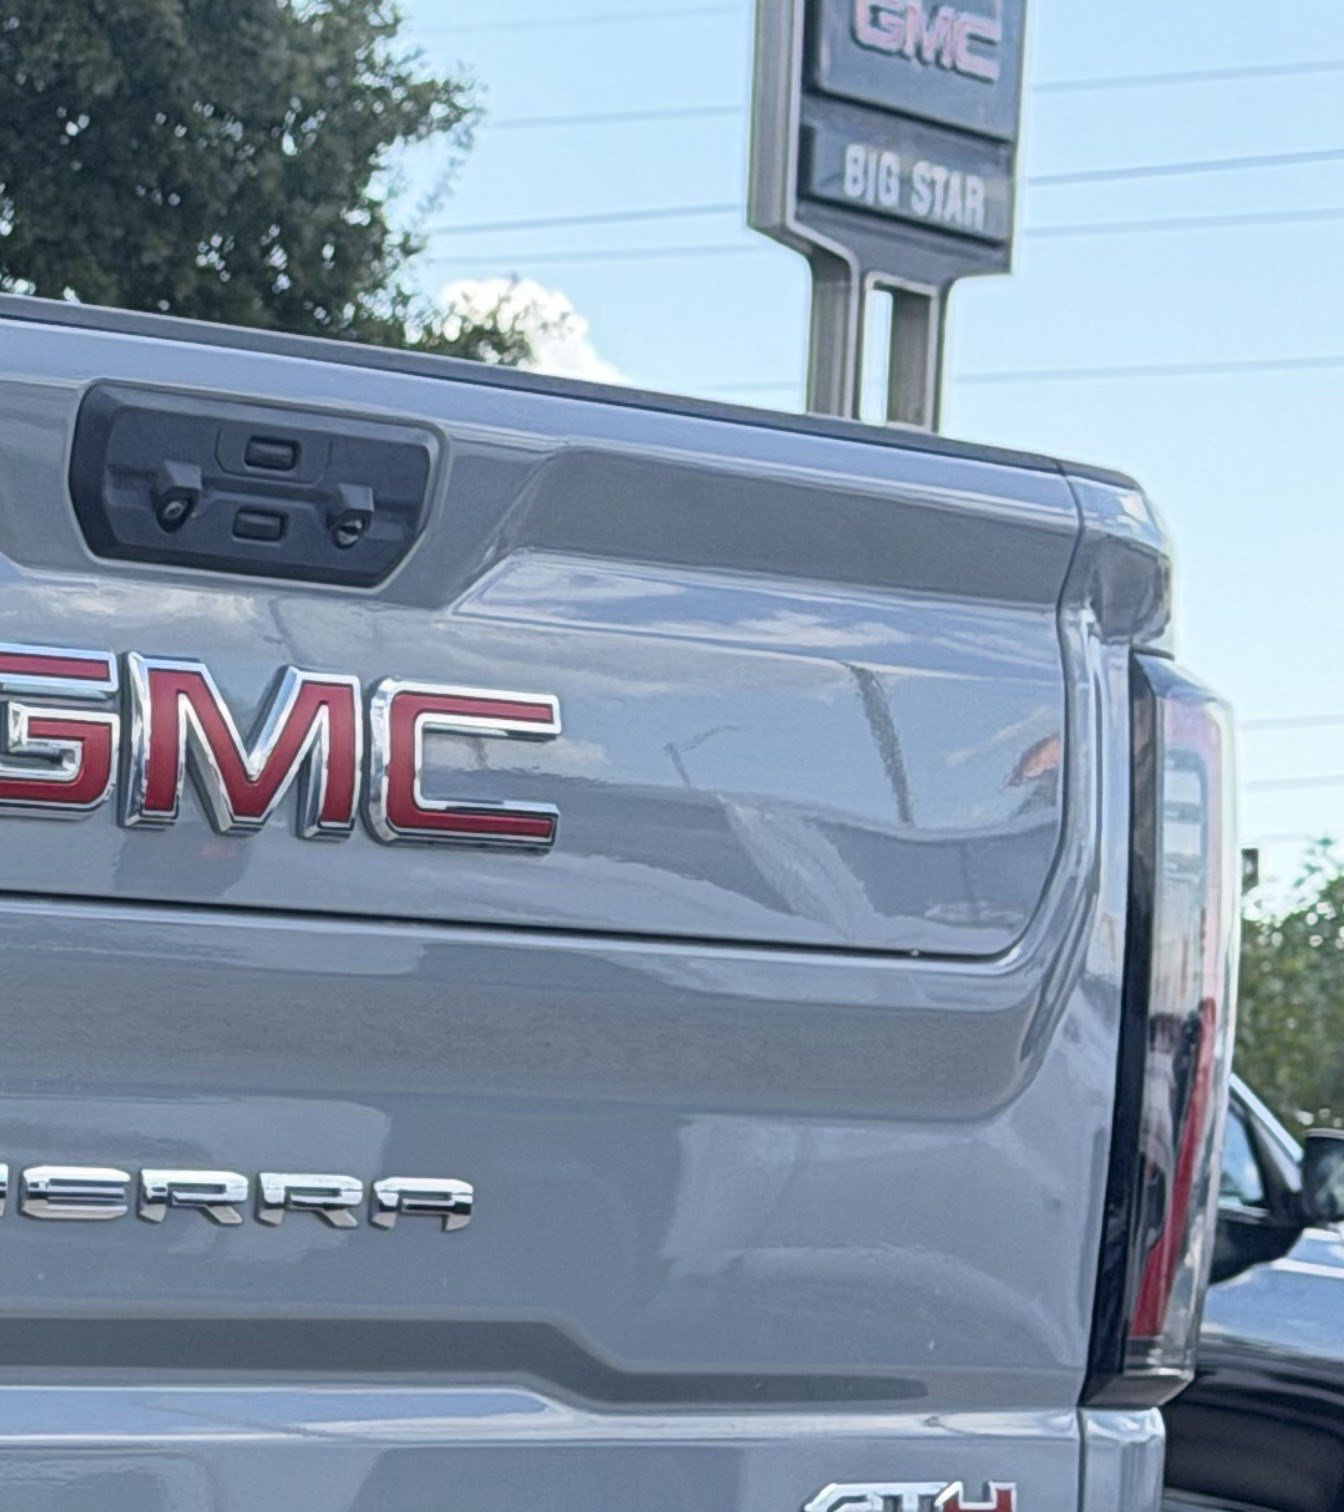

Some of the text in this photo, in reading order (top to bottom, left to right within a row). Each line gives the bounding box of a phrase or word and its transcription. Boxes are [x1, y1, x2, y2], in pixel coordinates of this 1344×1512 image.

[852, 0, 1002, 83] GMC
[844, 143, 986, 230] BIG STAR
